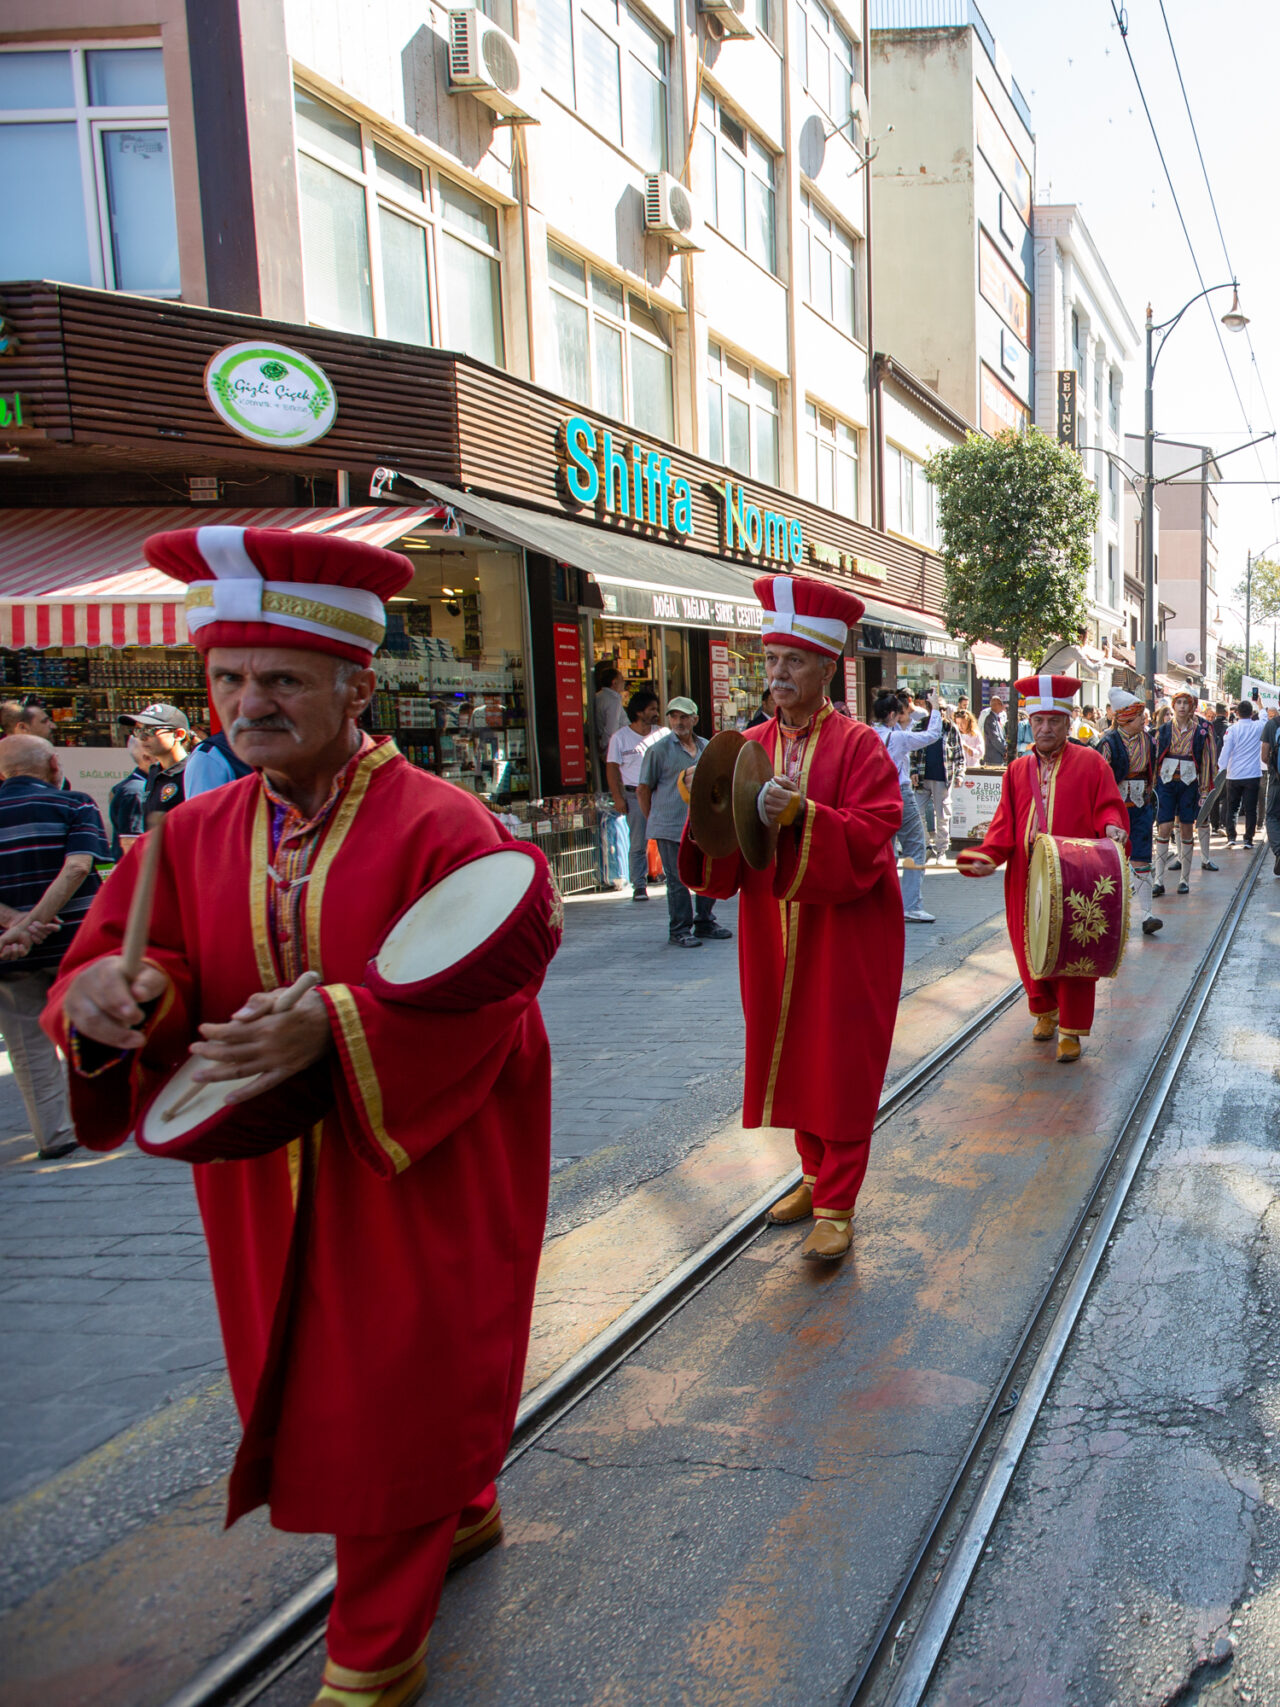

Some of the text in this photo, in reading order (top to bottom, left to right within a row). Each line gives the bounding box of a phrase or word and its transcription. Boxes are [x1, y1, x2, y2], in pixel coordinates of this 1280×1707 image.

[234, 378, 311, 402] Gizli Çiçek
[1061, 371, 1073, 436] SEVİNÇ
[565, 415, 695, 536] Shiffa
[653, 594, 680, 618] DOĞAL
[983, 782, 1001, 790] BUR
